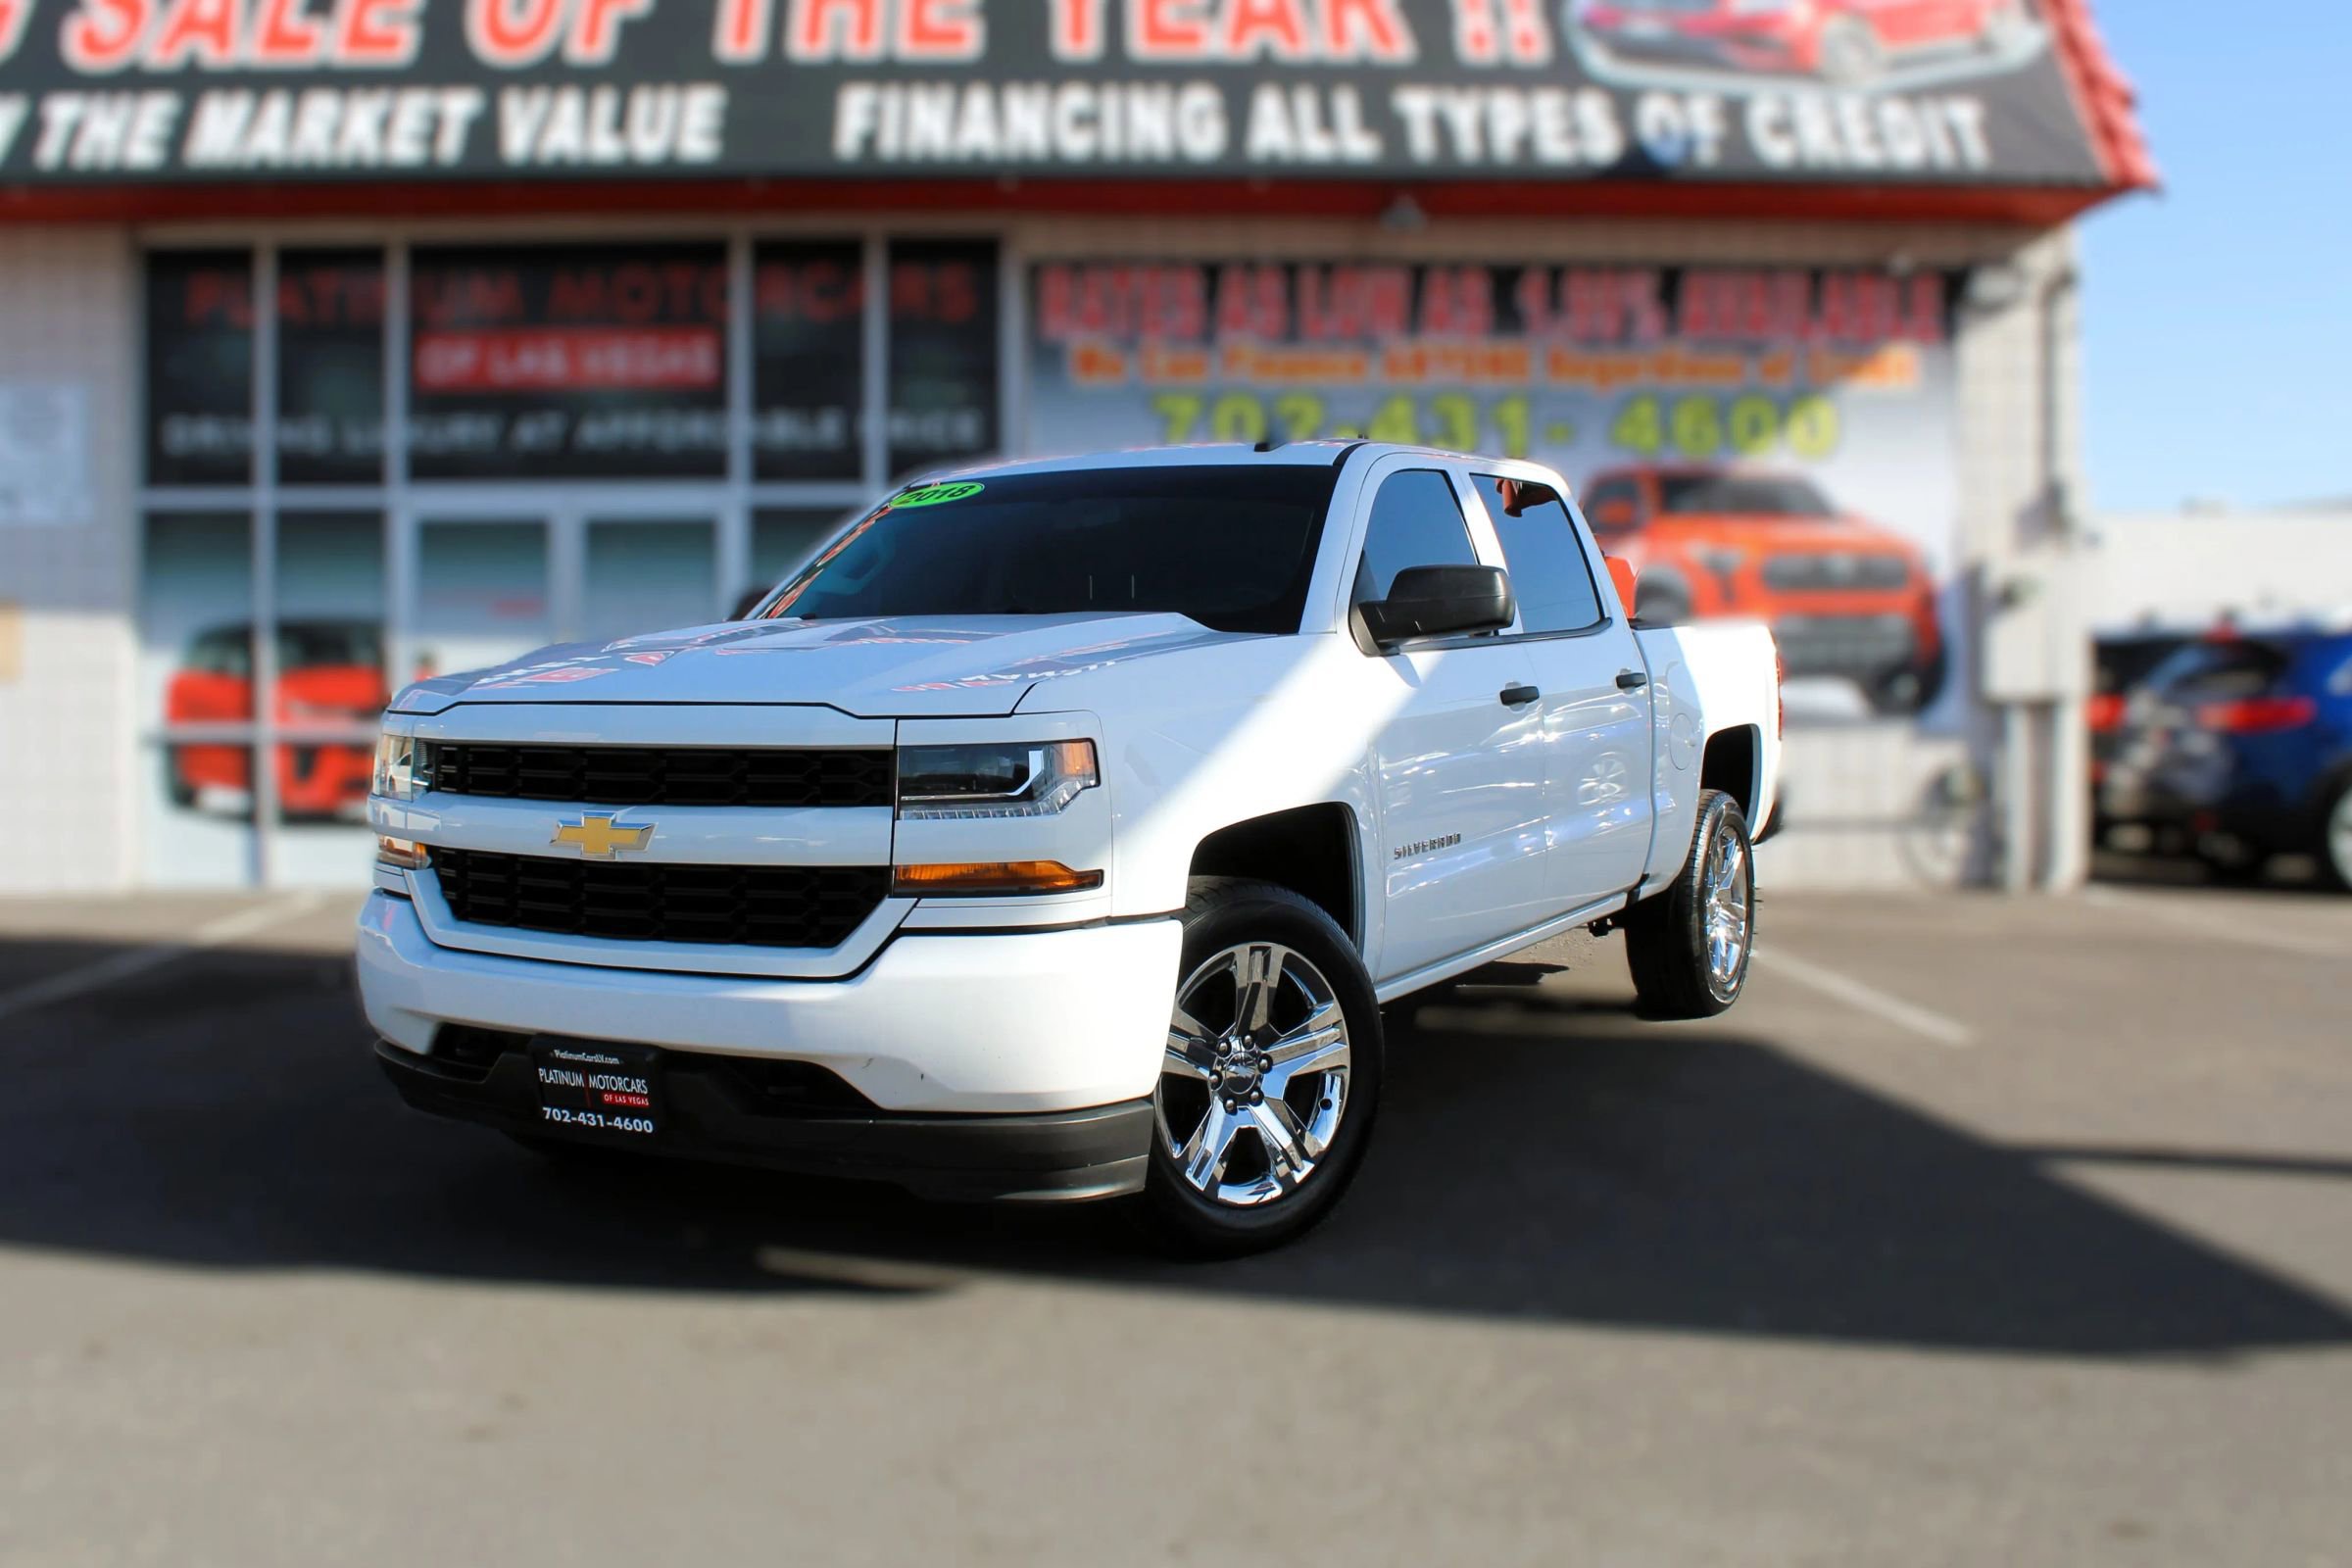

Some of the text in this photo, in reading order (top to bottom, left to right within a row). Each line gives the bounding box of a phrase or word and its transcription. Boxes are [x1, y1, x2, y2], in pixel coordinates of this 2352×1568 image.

[35, 89, 178, 170] THE
[185, 86, 484, 168] MARKET
[499, 82, 726, 165] VALUE
[835, 82, 1990, 169] FINANCING ALL TYPES OF CREDIT
[1039, 267, 1206, 340] RATES
[1298, 267, 1411, 340] LOW
[896, 484, 977, 506] 2018
[538, 1067, 649, 1095] PLATINUM MOTORCARS
[628, 1097, 650, 1106] VEGAS
[542, 1106, 654, 1134] 702-431-4600
